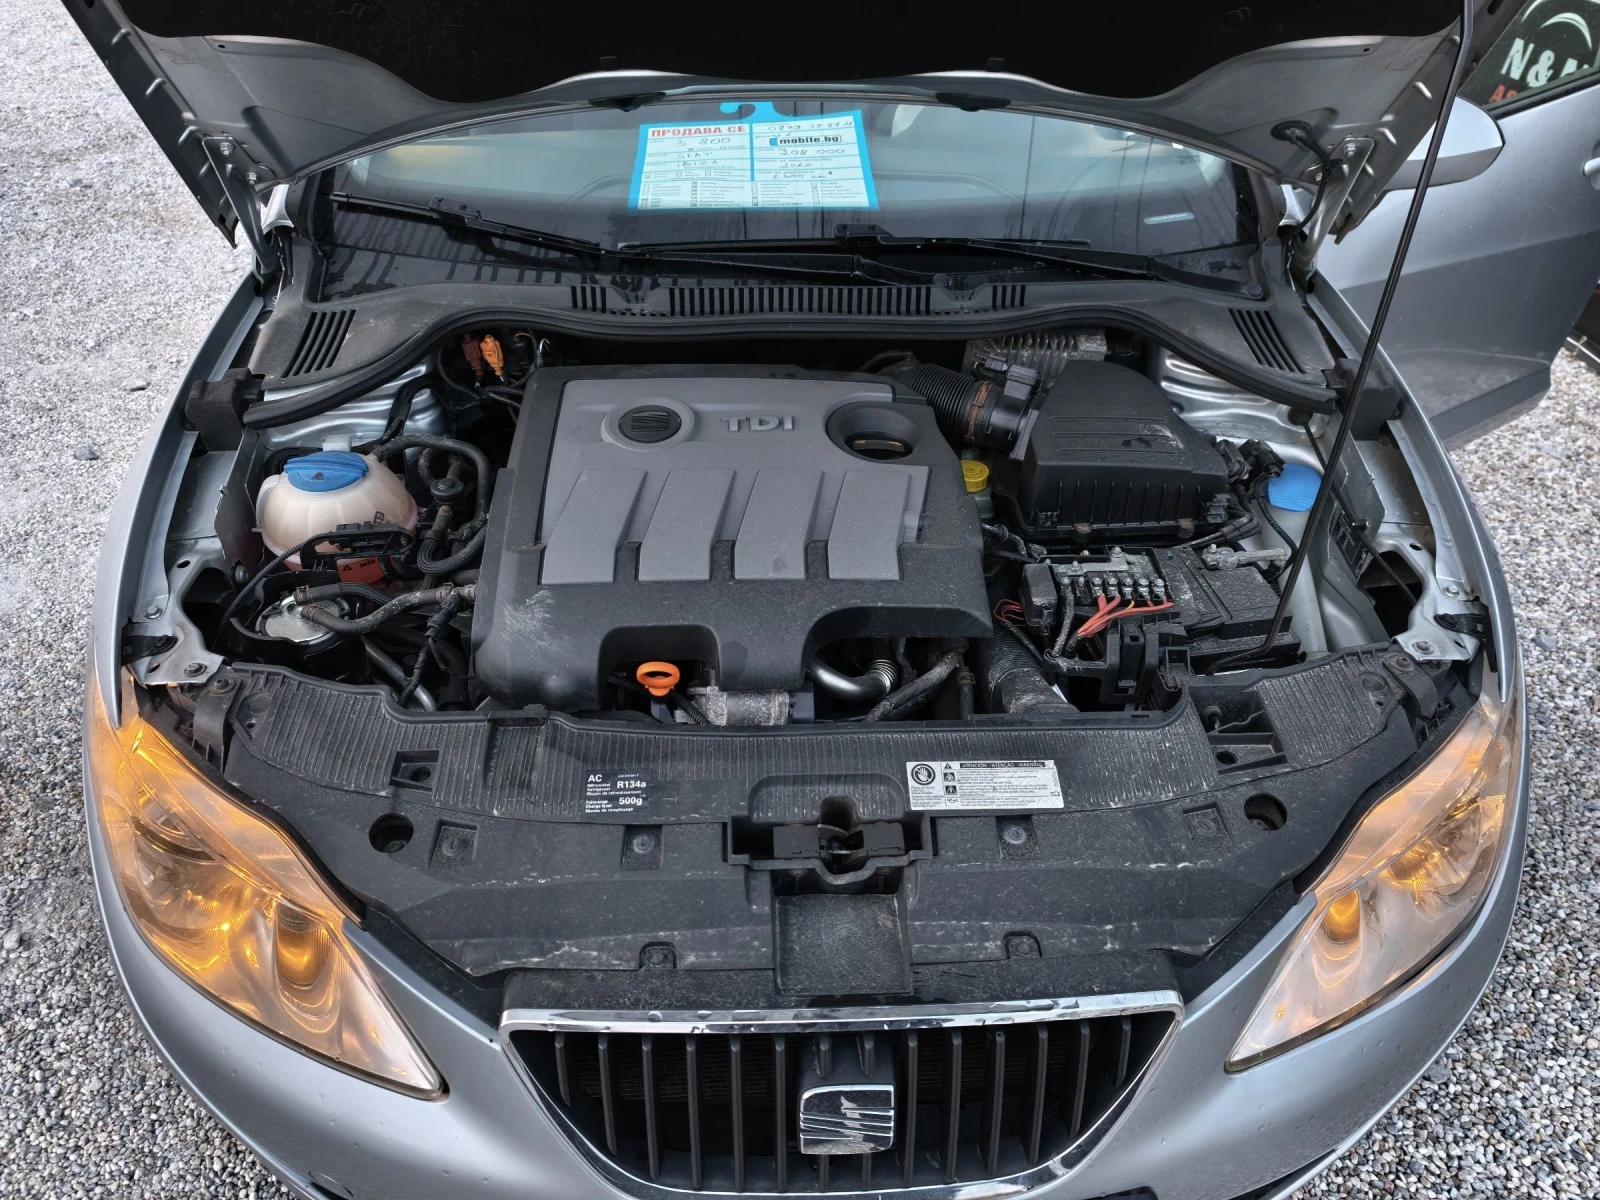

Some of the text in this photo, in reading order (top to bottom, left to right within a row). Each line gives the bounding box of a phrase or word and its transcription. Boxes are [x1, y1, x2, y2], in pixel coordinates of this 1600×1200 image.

[651, 125, 746, 137] ПРОДАВА СЕ
[698, 137, 731, 145] 800
[779, 134, 839, 144] mobile.bg
[779, 148, 808, 156] 208
[720, 415, 795, 433] TDI
[588, 774, 603, 783] AC
[617, 780, 646, 789] R134a
[618, 796, 643, 806] 500g
